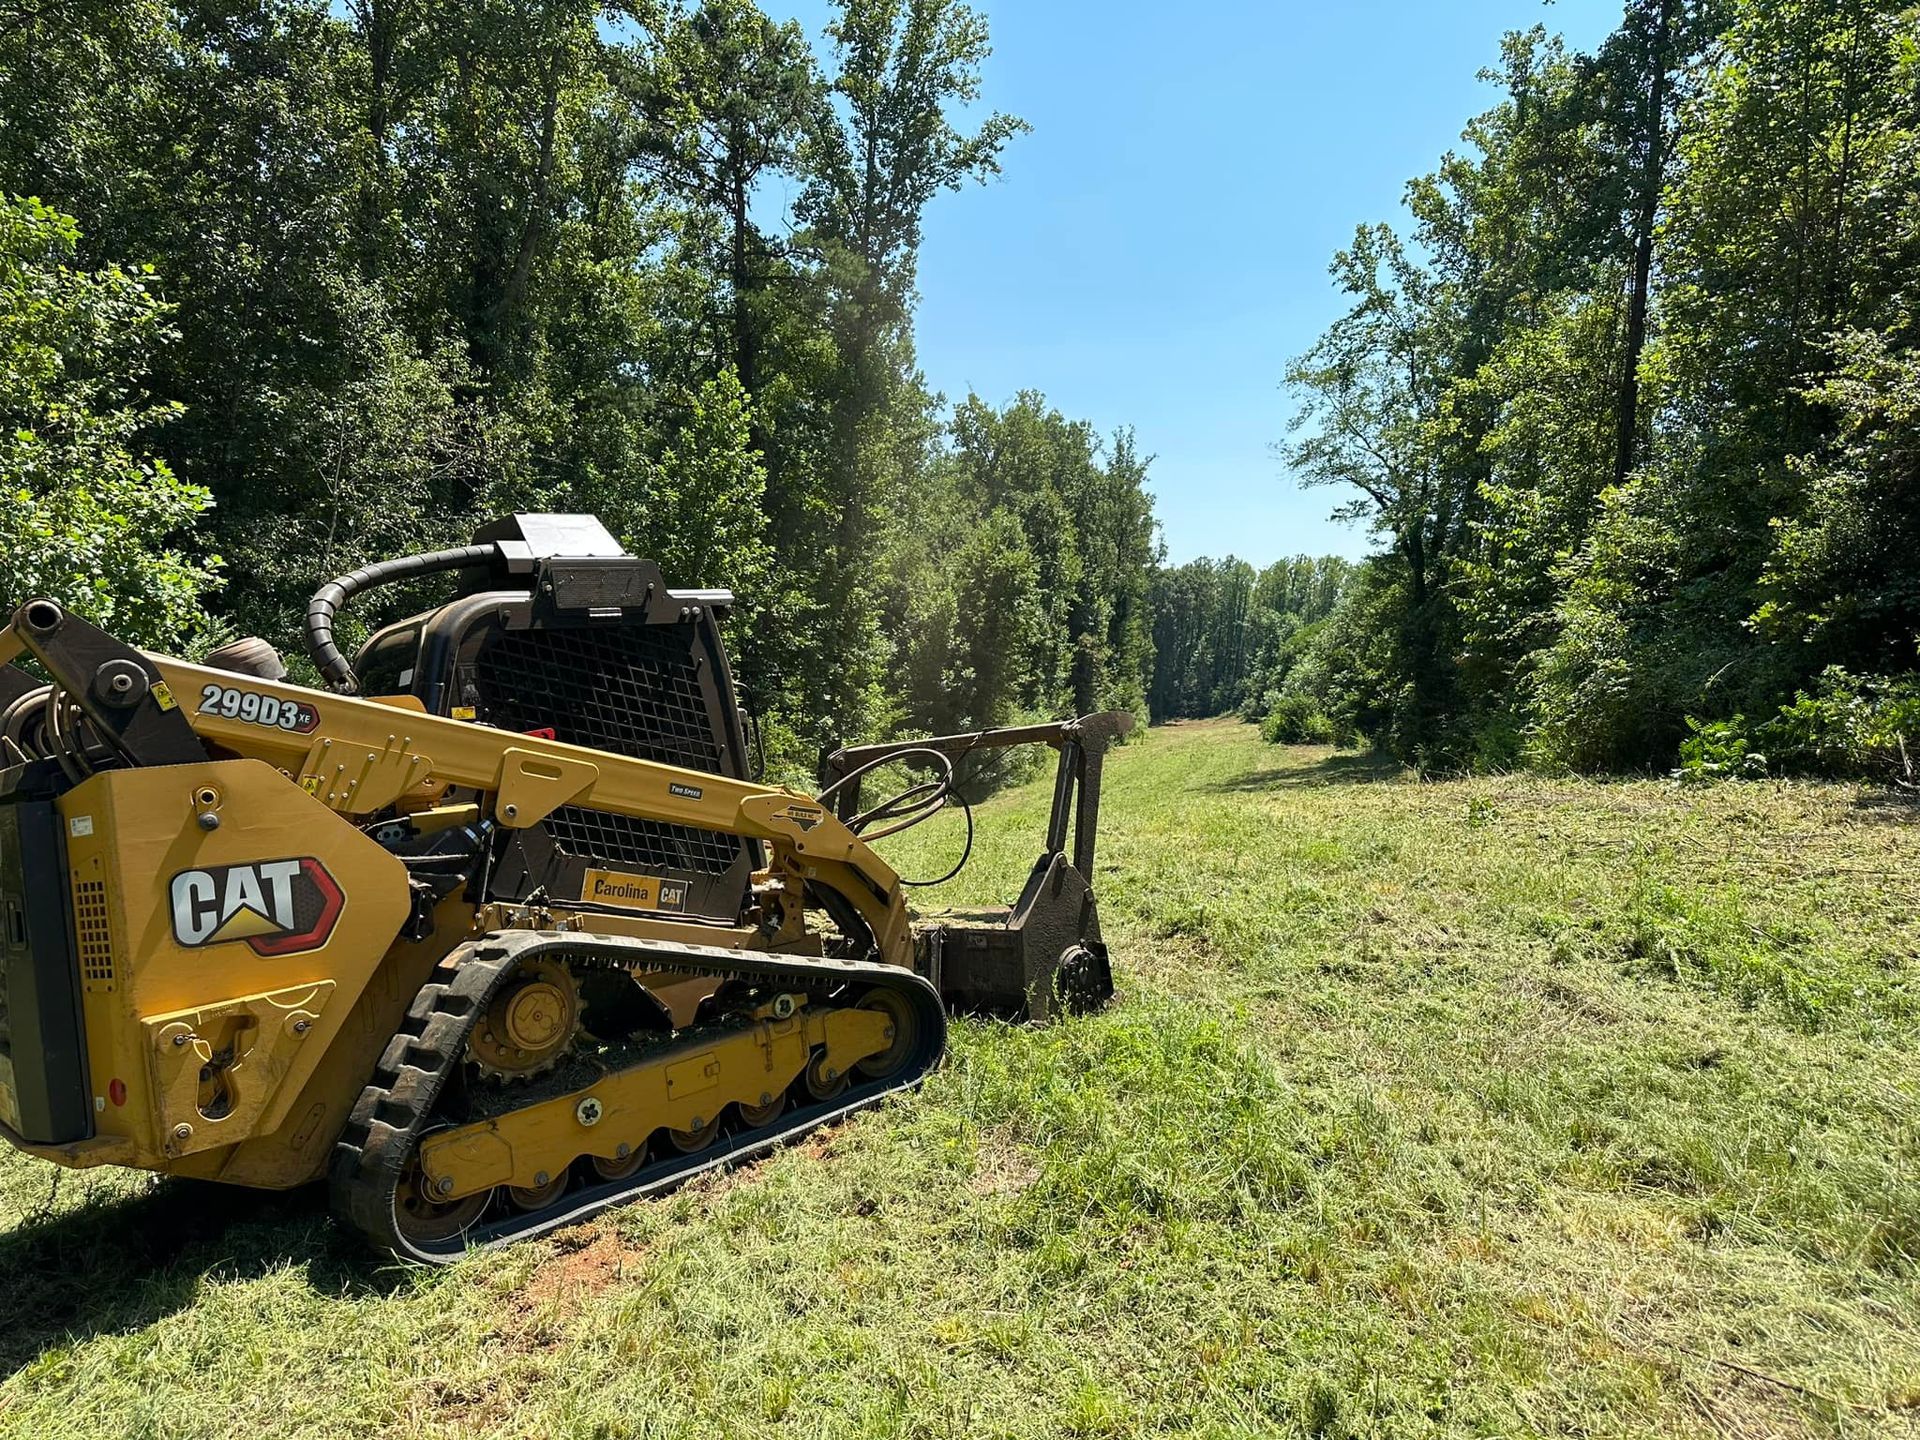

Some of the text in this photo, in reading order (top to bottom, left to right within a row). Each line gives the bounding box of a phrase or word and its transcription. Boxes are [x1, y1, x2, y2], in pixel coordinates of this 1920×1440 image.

[199, 684, 311, 730] 299D3 XE
[171, 860, 301, 945] CAT
[594, 879, 683, 904] Carolina CAT
